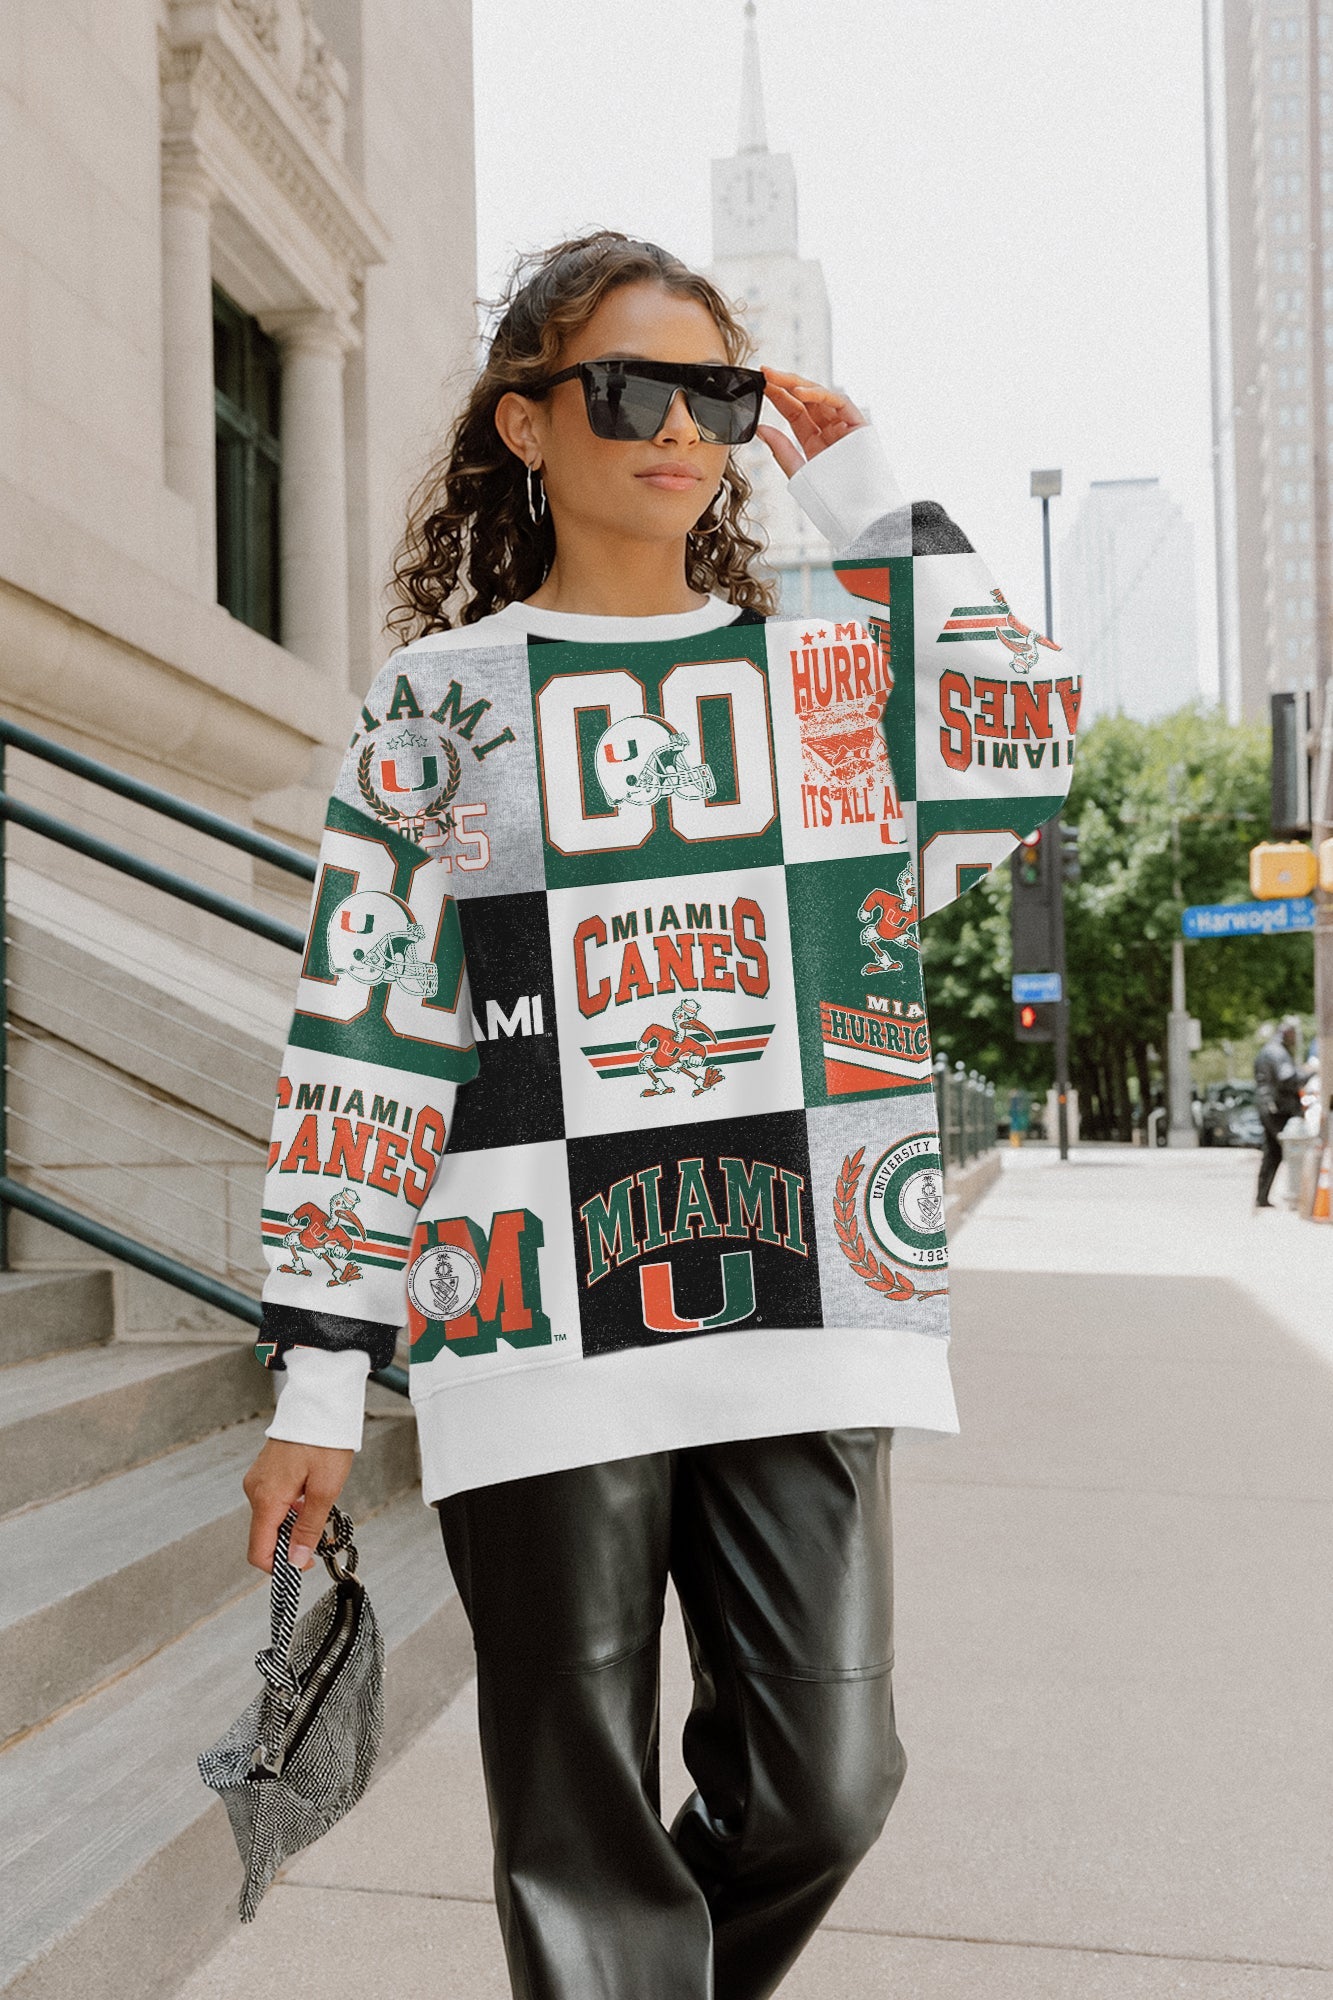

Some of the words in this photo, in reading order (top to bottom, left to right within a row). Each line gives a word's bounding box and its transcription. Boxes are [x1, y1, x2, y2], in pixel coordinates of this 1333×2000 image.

[351, 674, 517, 762] IAMI
[381, 756, 439, 792] U
[604, 739, 639, 763] U
[801, 784, 833, 828] ITS
[841, 787, 875, 824] ALL
[341, 911, 375, 934] U
[611, 902, 733, 943] MIAMI
[573, 896, 771, 1020] CANES
[295, 1083, 413, 1133] MIAMI
[872, 1141, 930, 1200] UNIVERSITY
[580, 1156, 809, 1288] MIAMI
[639, 1250, 757, 1333] U
